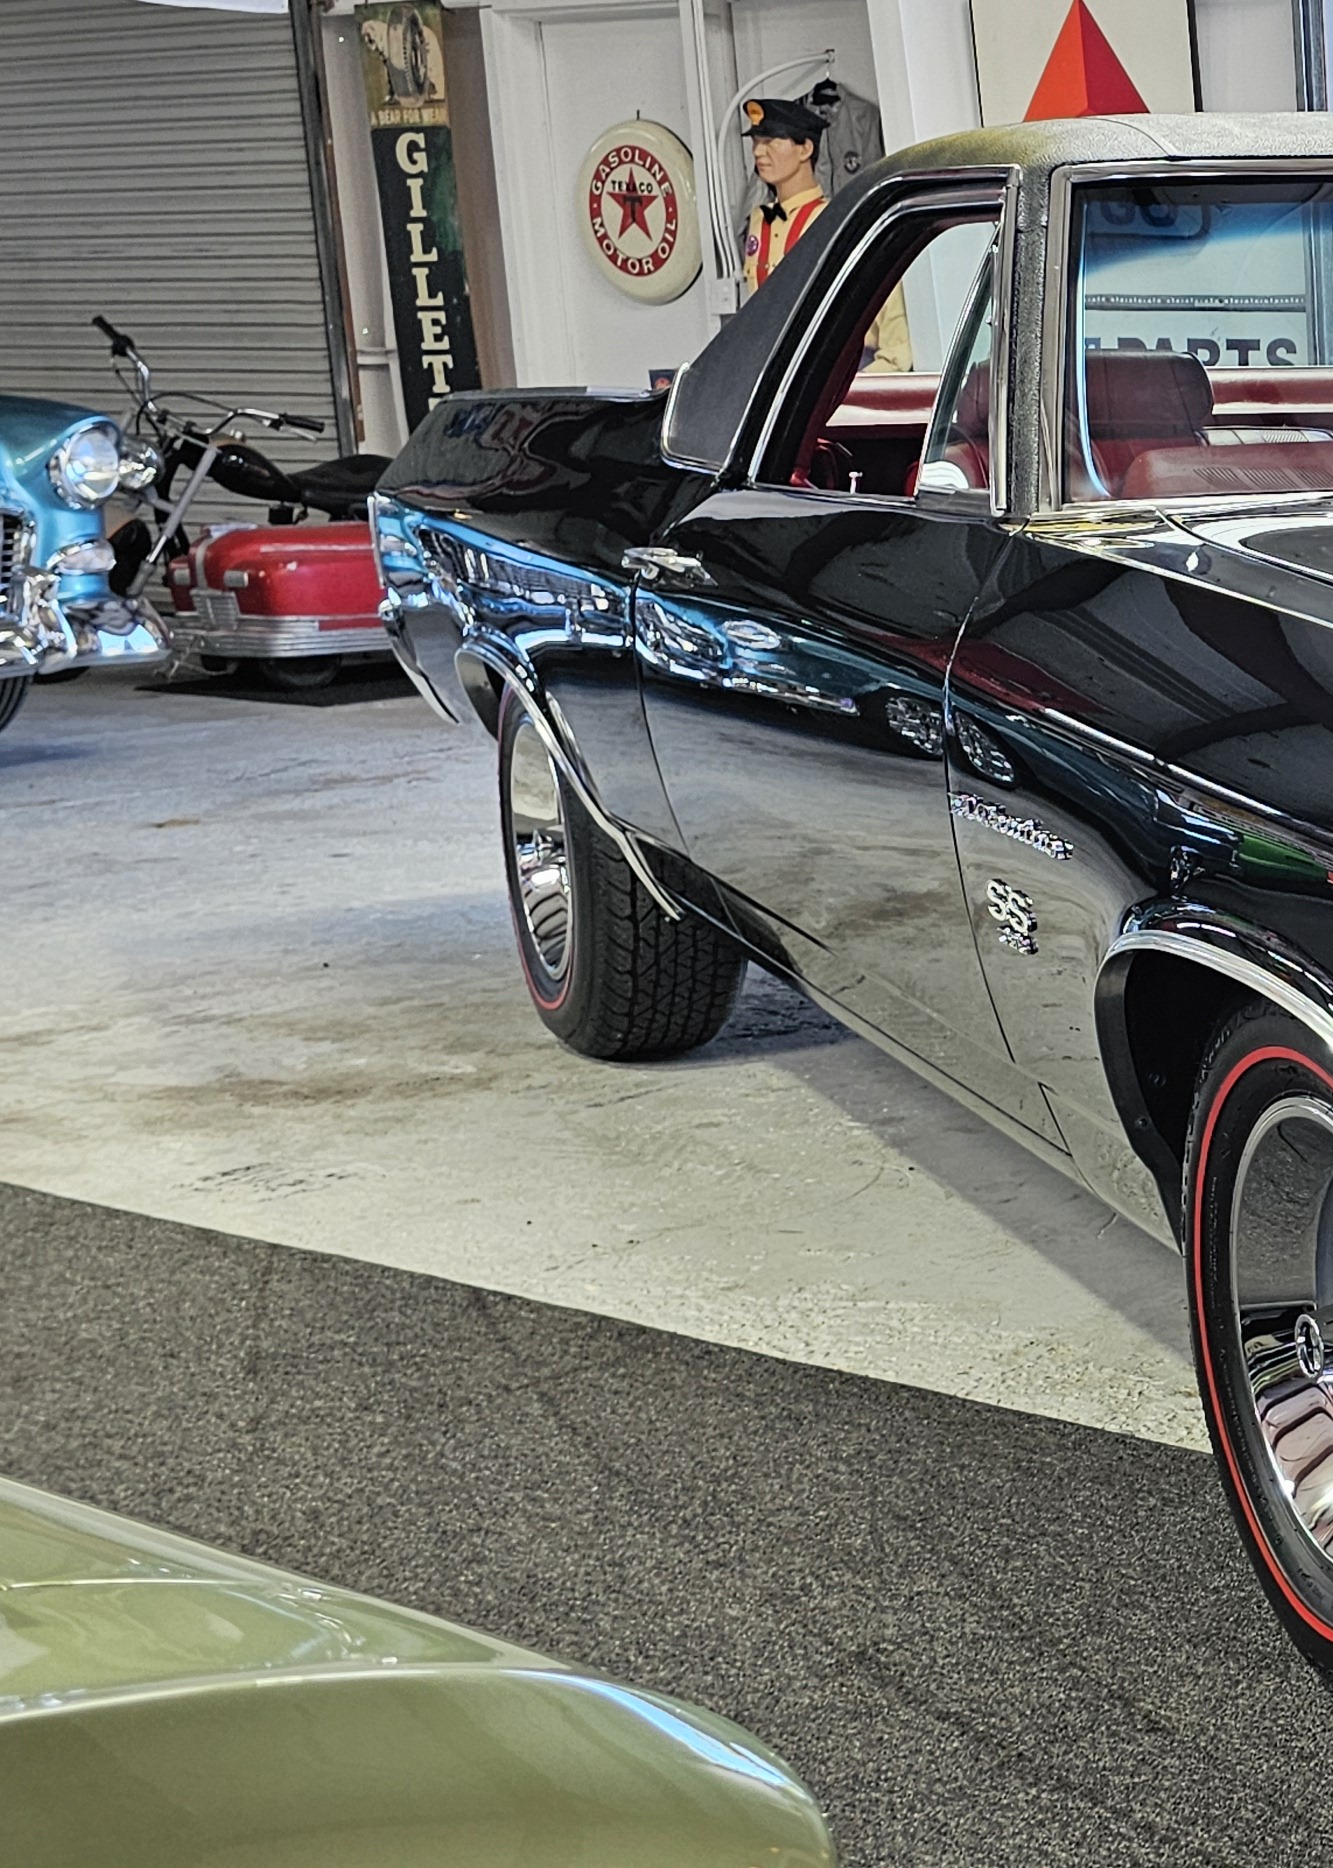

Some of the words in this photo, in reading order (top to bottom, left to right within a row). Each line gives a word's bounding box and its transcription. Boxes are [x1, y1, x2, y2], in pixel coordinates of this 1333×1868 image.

[591, 146, 673, 198] GASOLINE
[592, 216, 655, 274] MOTOR
[656, 218, 677, 260] OIL
[986, 879, 1033, 937] SS
